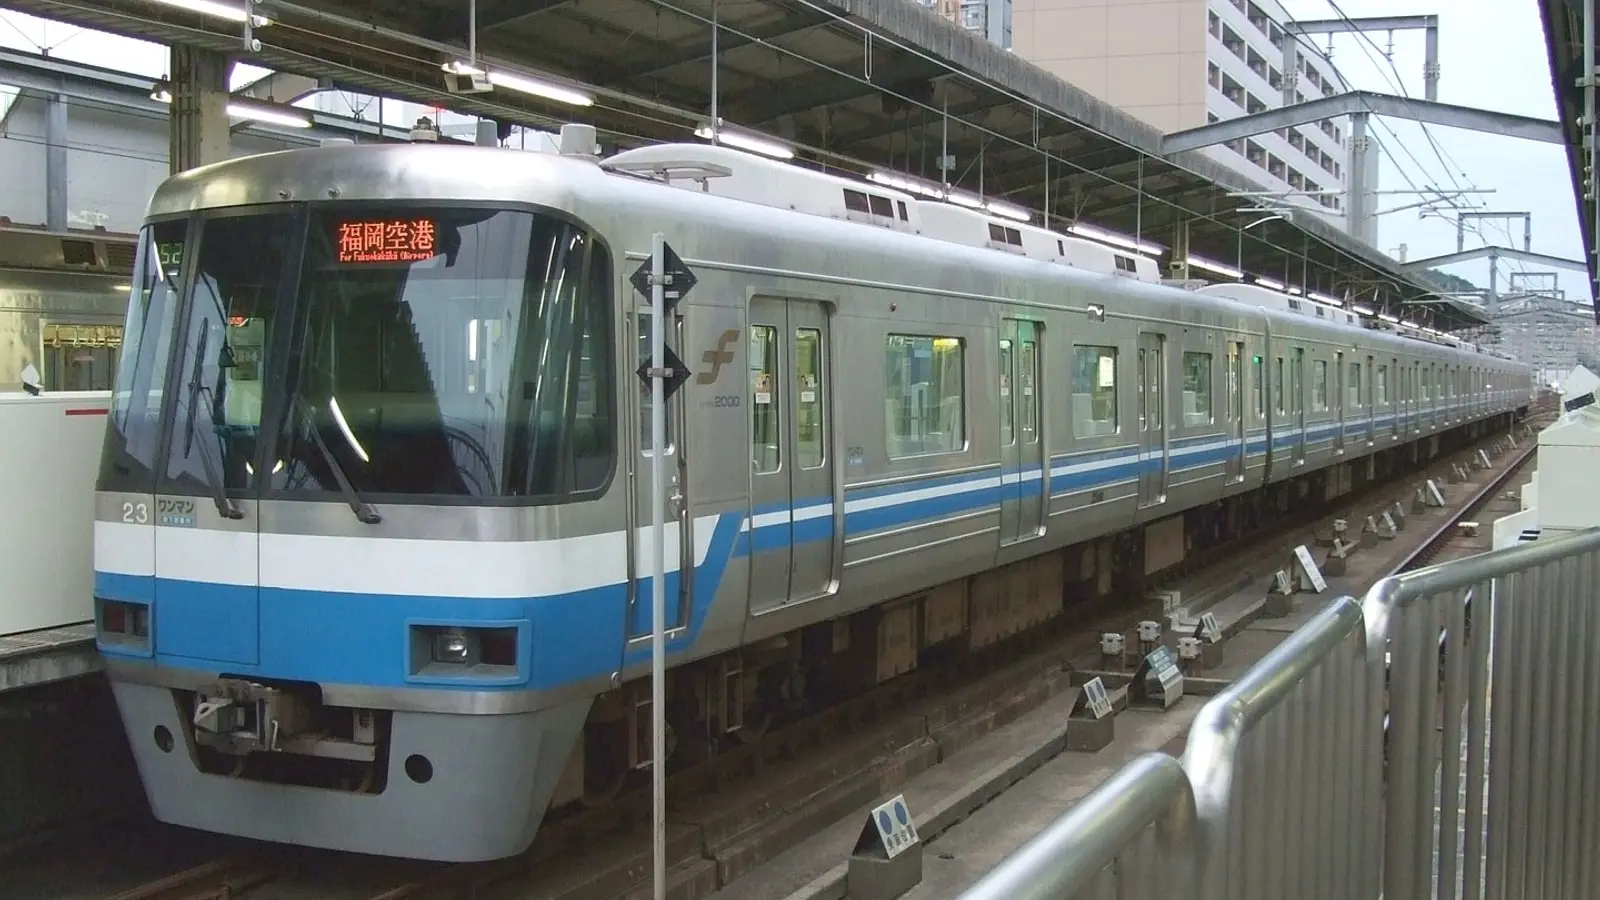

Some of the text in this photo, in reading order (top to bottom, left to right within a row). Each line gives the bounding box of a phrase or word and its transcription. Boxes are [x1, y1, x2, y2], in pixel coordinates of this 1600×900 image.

[339, 220, 434, 250] 福岡空港
[160, 243, 183, 264] 52
[715, 395, 740, 408] 2000
[123, 502, 148, 523] 23
[158, 499, 195, 514] ワンマン
